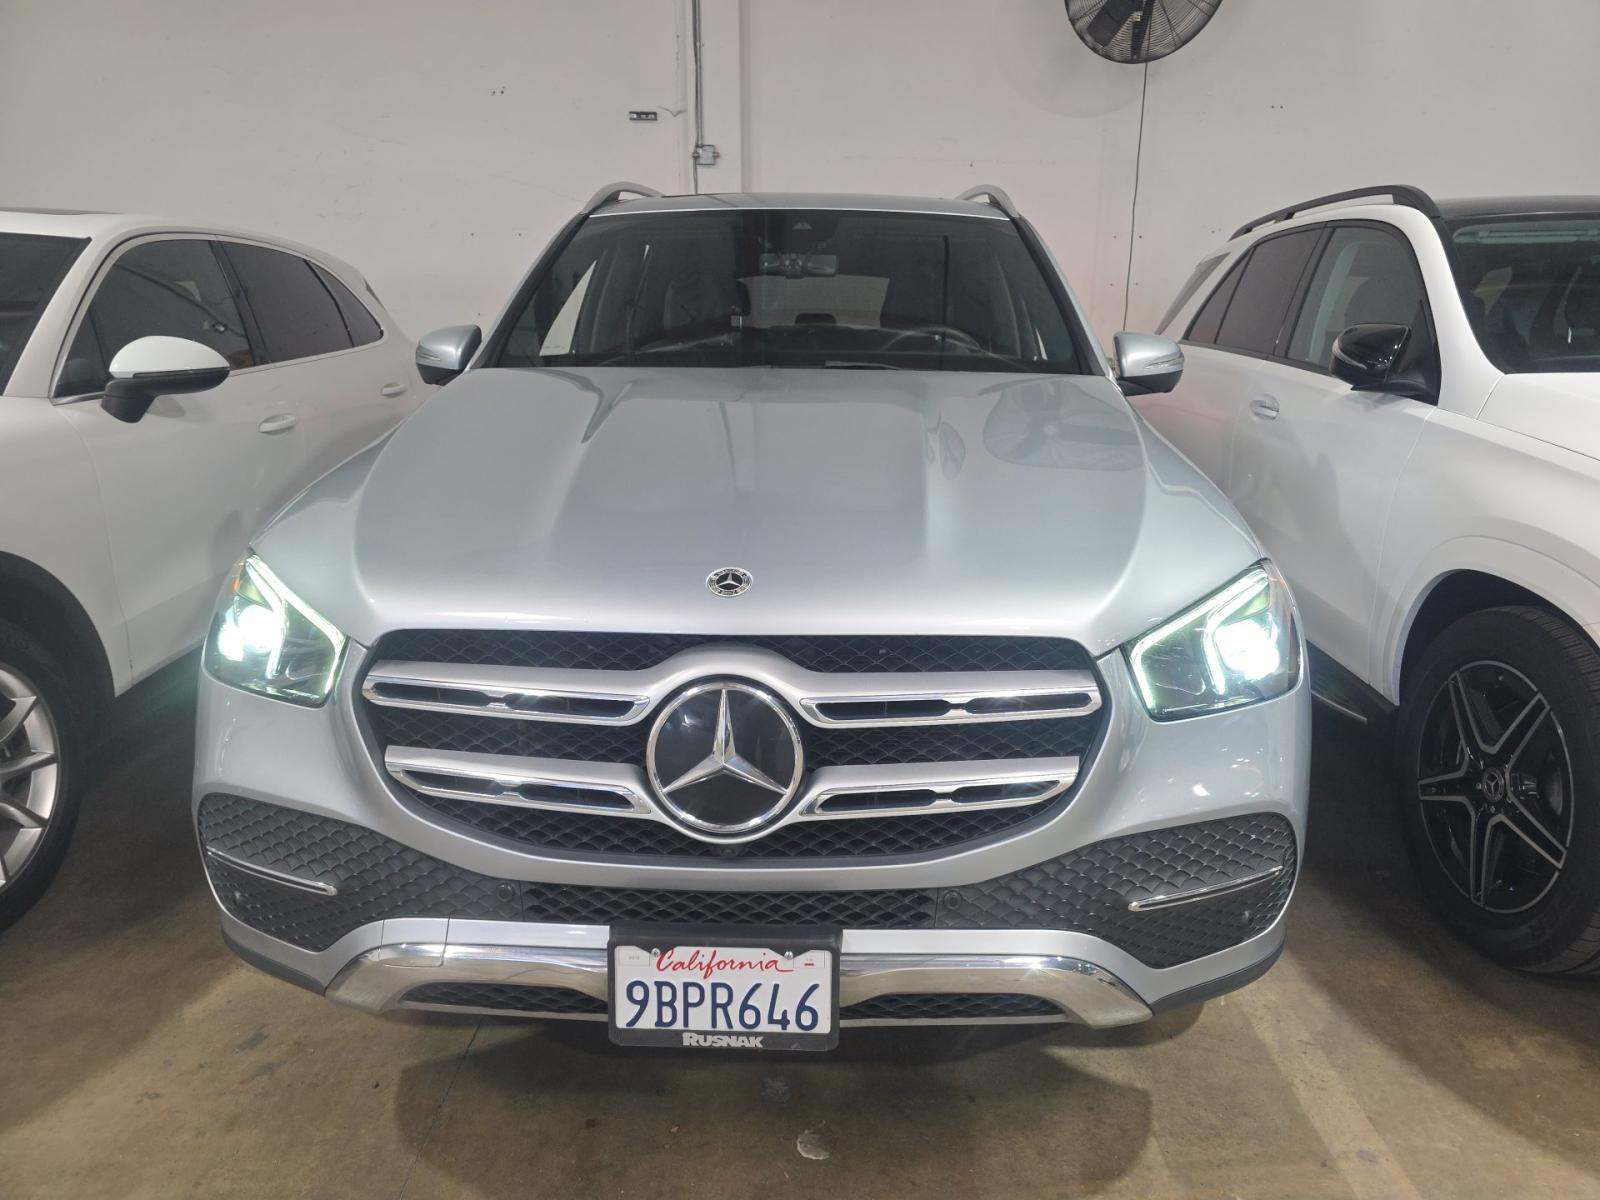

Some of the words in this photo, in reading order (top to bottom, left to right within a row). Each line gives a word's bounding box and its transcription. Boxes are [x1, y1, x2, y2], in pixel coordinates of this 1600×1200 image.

[656, 949, 794, 979] California
[625, 980, 820, 1031] 9BPR646
[682, 1032, 764, 1048] RUSNAK
